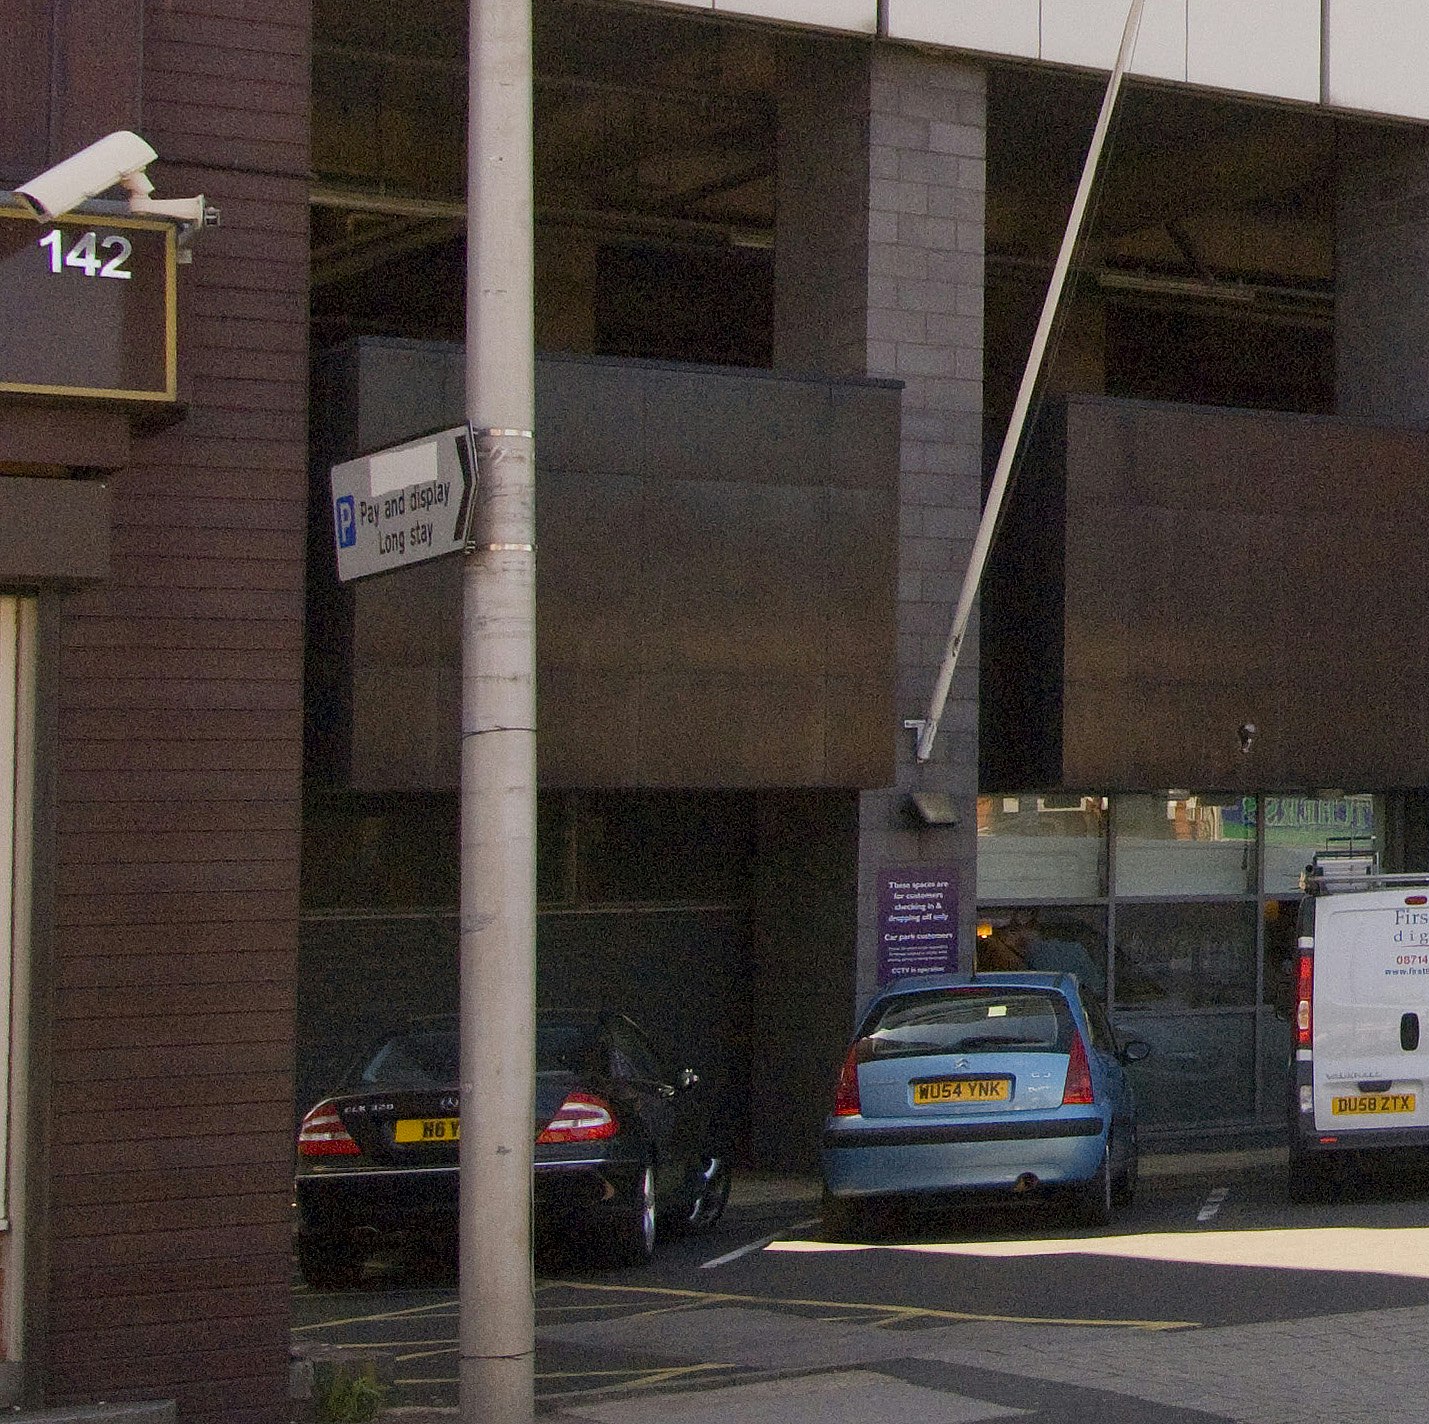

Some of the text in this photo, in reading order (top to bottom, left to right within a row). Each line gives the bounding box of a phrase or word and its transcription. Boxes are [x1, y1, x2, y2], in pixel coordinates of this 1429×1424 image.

[39, 229, 132, 279] 142
[360, 481, 450, 527] Pay and display
[379, 520, 433, 555] Long stay
[1396, 954, 1428, 965] 08714
[919, 1081, 1001, 1100] WU54 YNK
[1338, 1095, 1411, 1112] DU58 ZTX
